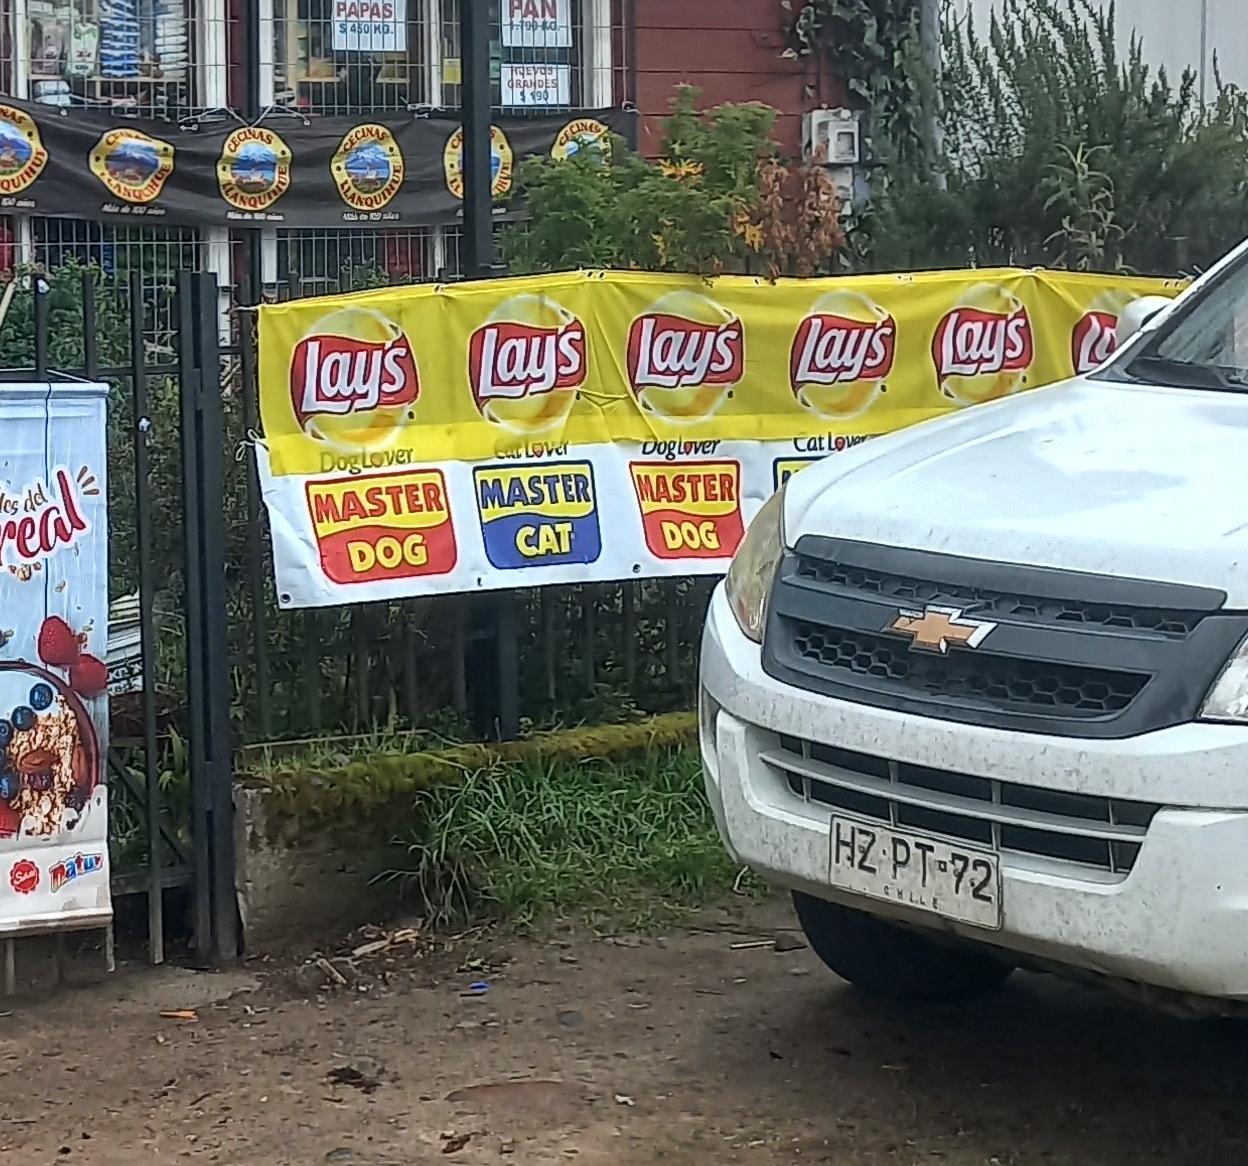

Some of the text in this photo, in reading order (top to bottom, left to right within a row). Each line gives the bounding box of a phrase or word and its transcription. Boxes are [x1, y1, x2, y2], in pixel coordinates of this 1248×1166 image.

[336, 2, 393, 19] PAPAS
[227, 128, 273, 153] CECINAS
[343, 127, 390, 153] CECINAS
[634, 316, 739, 388] Lay's
[795, 315, 892, 387] Lay's
[941, 312, 1026, 375] Lay's
[301, 336, 408, 414] Lay's
[479, 324, 583, 399] Lay's
[24, 483, 48, 512] del
[314, 482, 444, 523] MASTER
[480, 474, 592, 509] MASTER
[636, 473, 735, 503] MASTER
[515, 522, 574, 557] CAT
[661, 520, 721, 550] DOG
[347, 533, 428, 573] DOG
